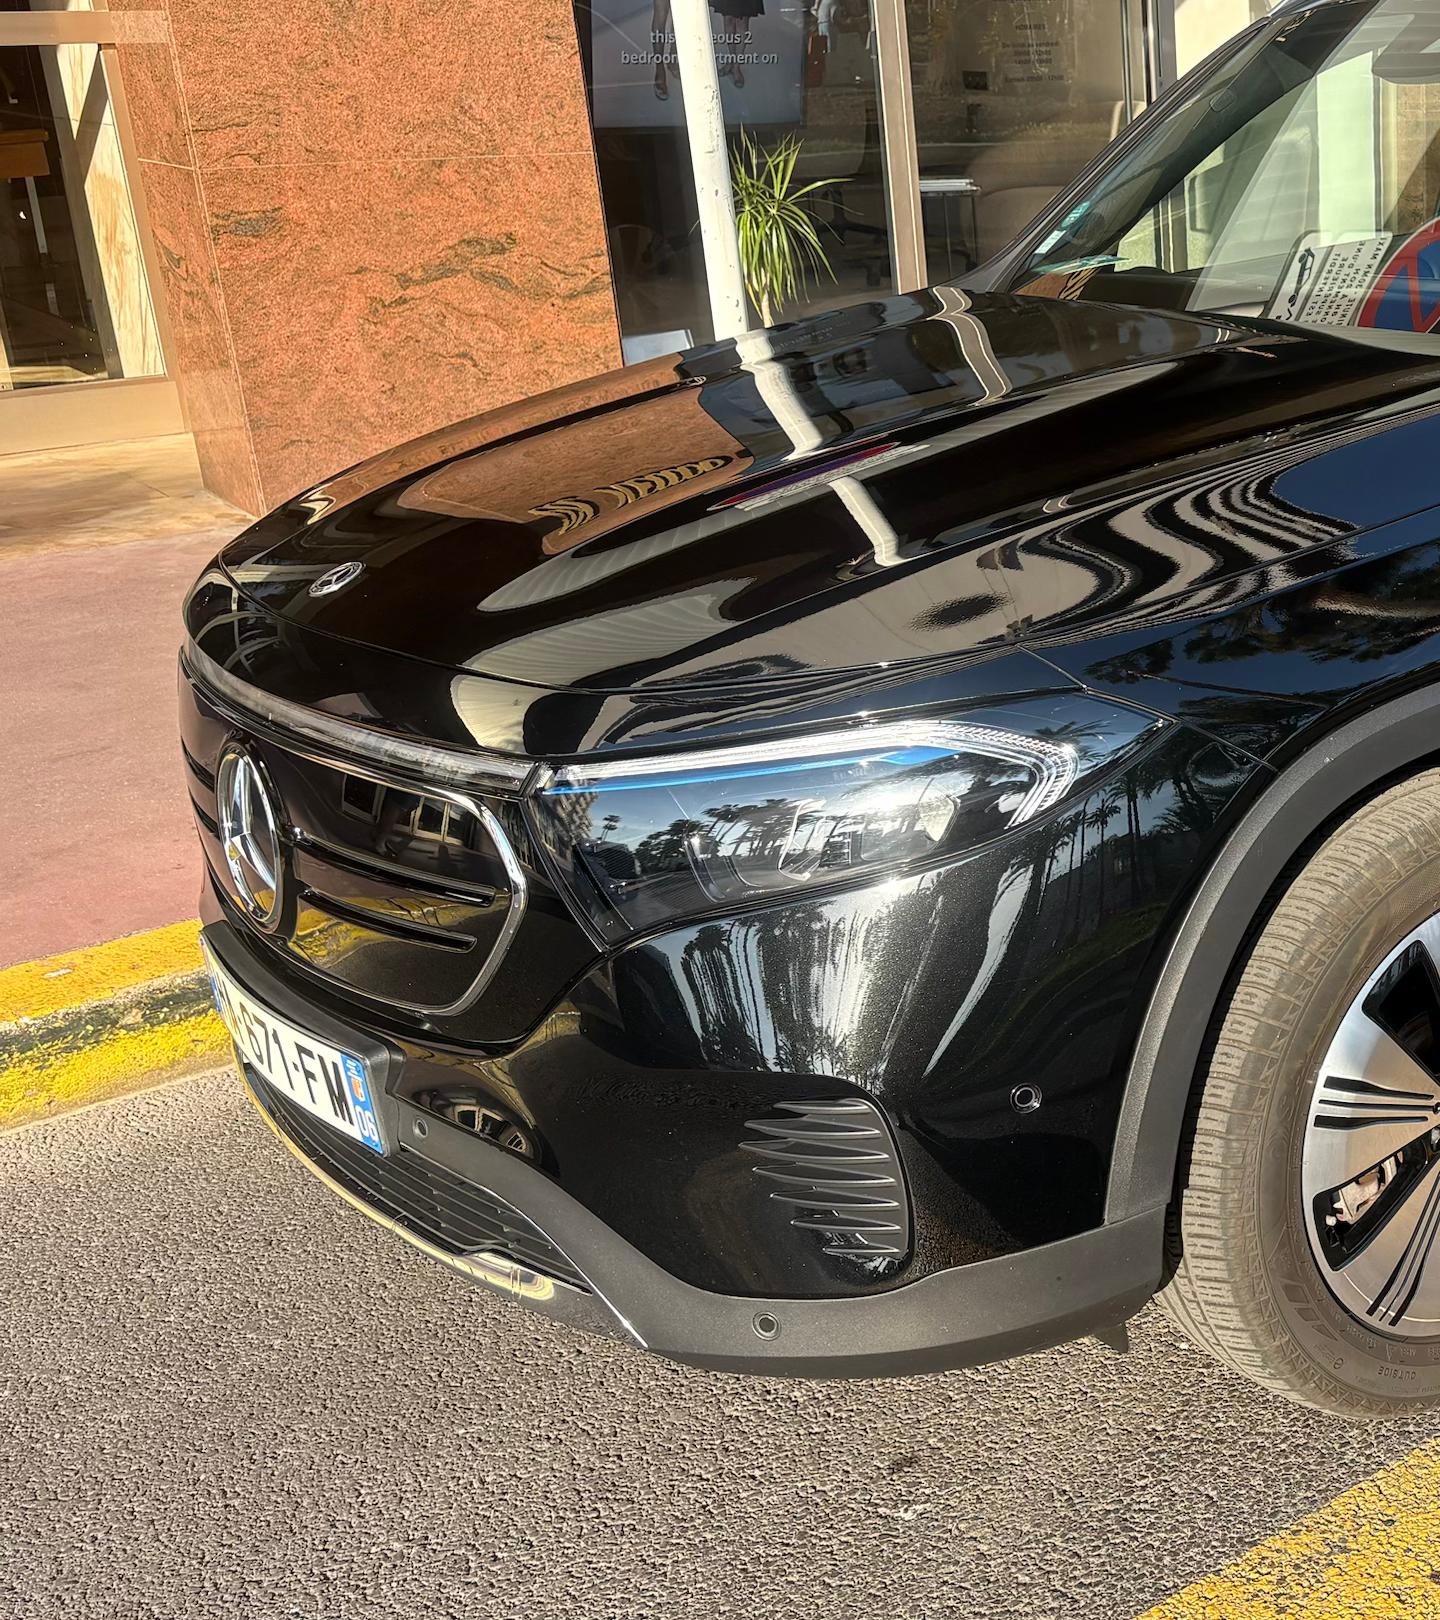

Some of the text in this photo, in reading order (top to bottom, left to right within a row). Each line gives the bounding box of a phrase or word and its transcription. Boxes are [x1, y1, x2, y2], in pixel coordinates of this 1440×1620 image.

[650, 31, 752, 44] this eous 2
[715, 53, 760, 64] rtment
[762, 54, 778, 64] on
[355, 1105, 379, 1143] 06
[1377, 1366, 1417, 1381] OUTSIDE
